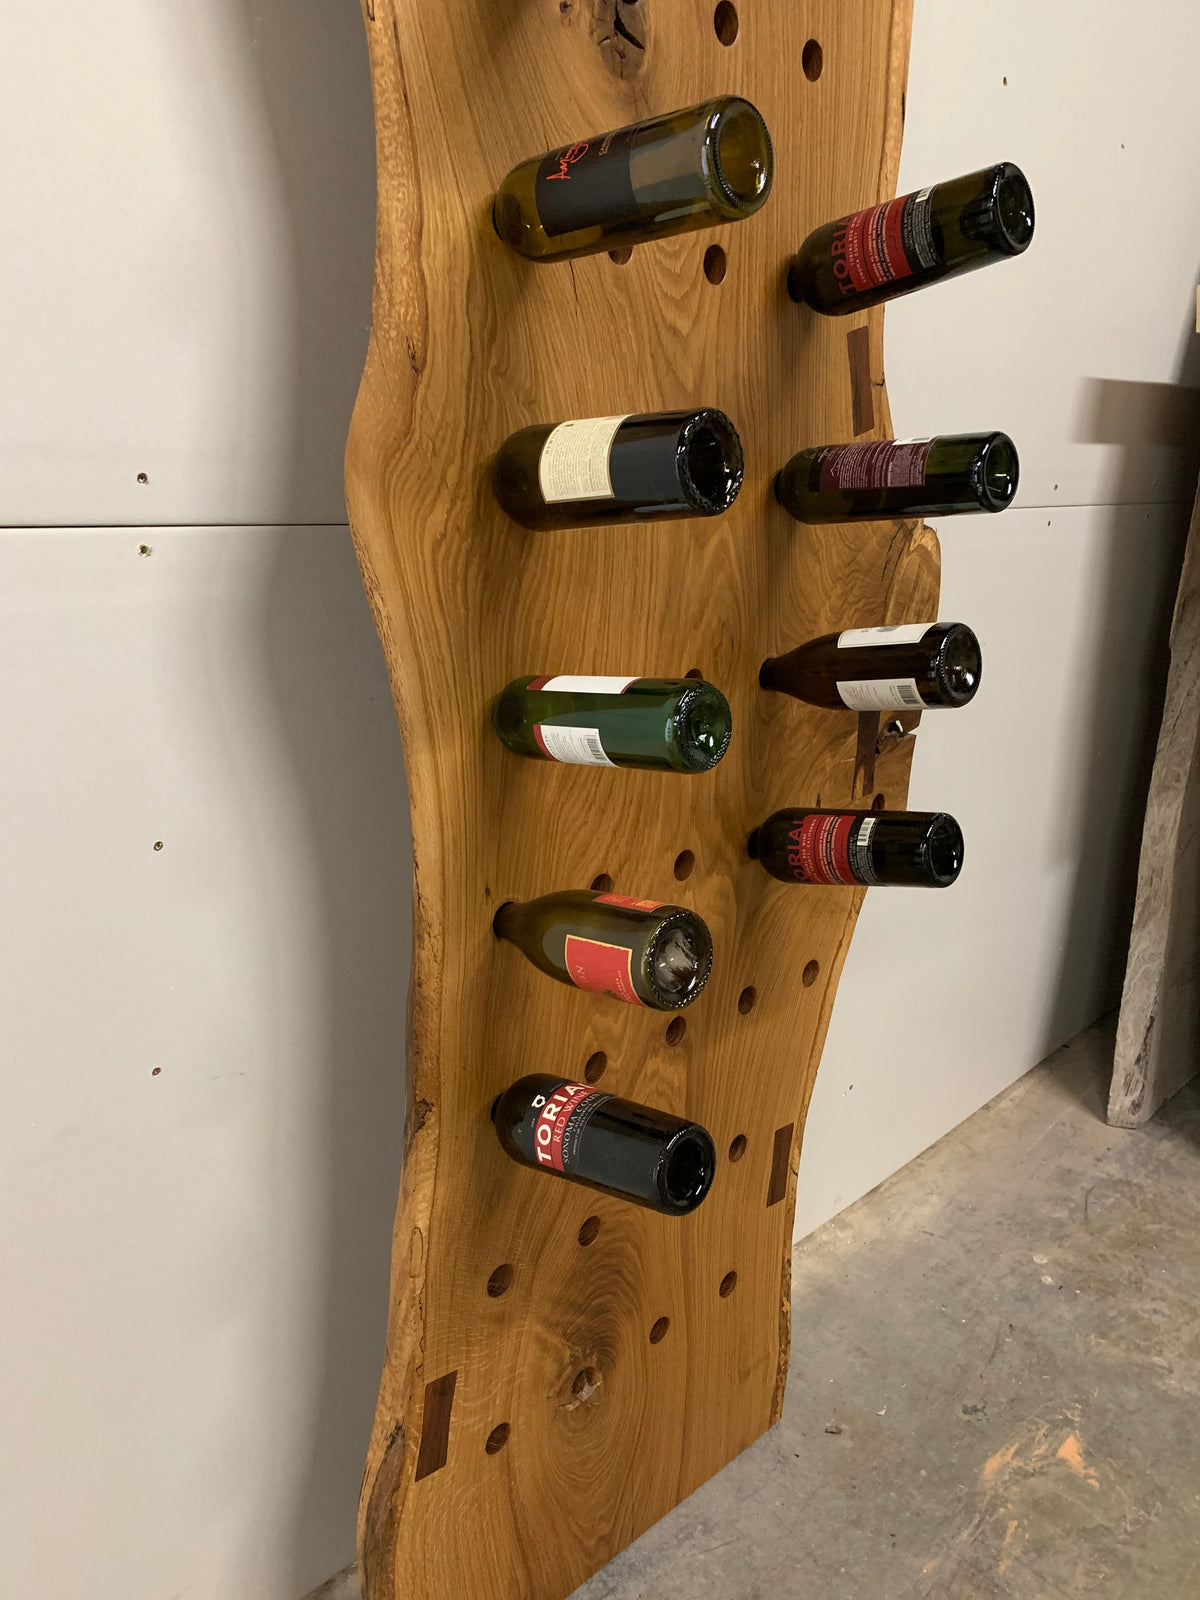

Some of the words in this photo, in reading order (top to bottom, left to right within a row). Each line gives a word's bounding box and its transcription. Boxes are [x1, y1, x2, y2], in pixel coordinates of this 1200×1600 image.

[553, 1116, 566, 1143] RED
[563, 1090, 589, 1113] WINE
[562, 1115, 579, 1164] SONOMA
